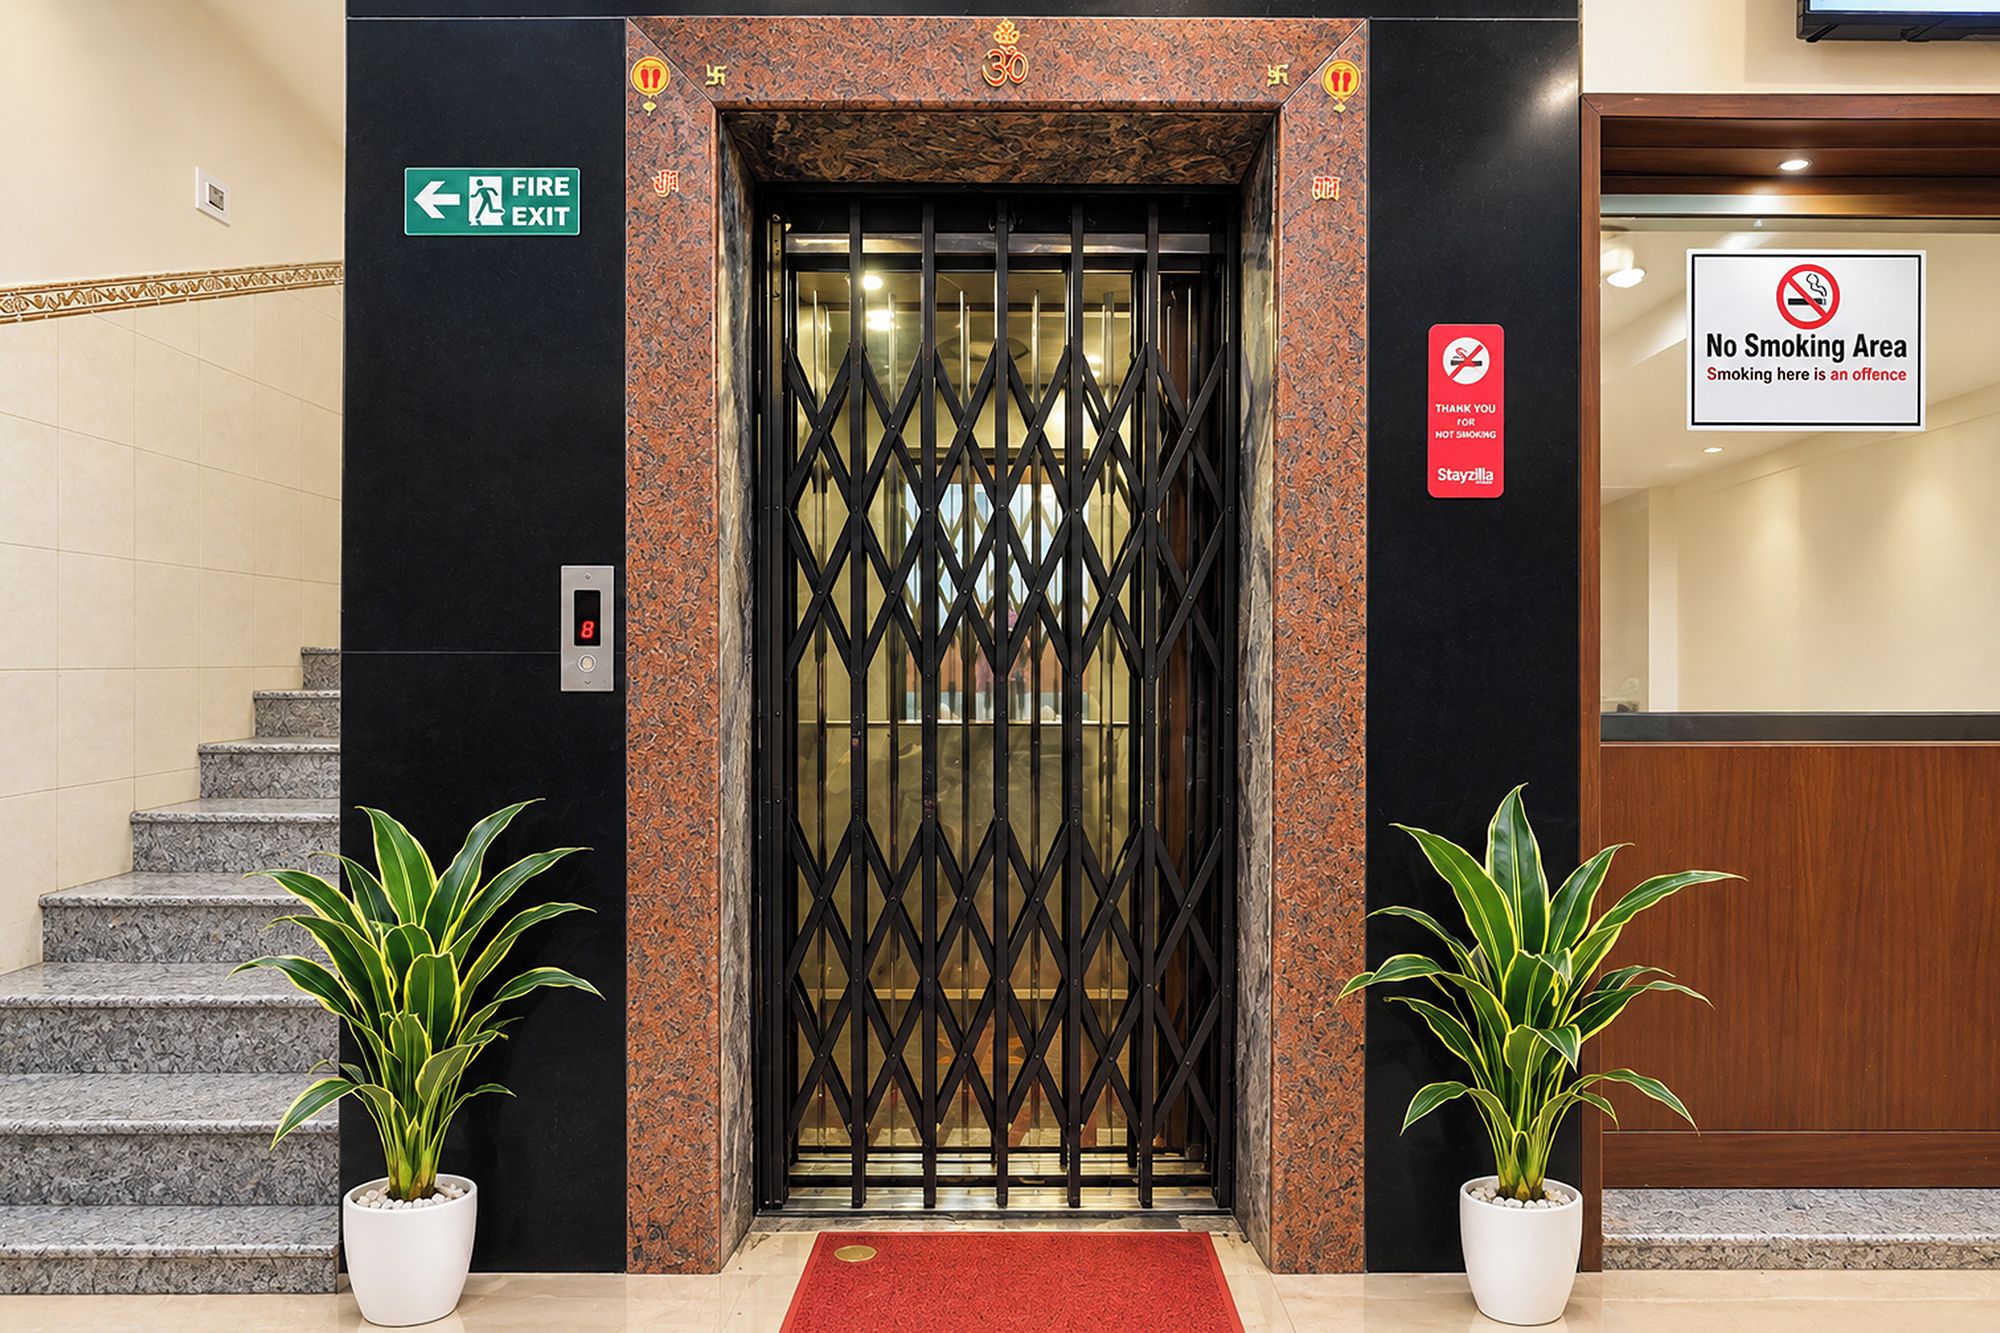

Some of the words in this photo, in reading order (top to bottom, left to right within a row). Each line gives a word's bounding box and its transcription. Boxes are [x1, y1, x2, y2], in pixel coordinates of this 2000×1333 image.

[512, 176, 570, 197] FIRE
[512, 207, 571, 226] EXIT
[1706, 333, 1737, 358] No
[1745, 333, 1845, 363] Smoking
[1852, 333, 1907, 358] Area
[1707, 367, 1773, 384] Smoking
[1777, 367, 1810, 381] here
[1814, 367, 1826, 381] is
[1830, 370, 1847, 381] an
[1852, 367, 1907, 381] offence
[1435, 404, 1471, 413] THANK
[1473, 404, 1496, 413] YOU
[1457, 418, 1475, 426] FOR
[1435, 431, 1455, 439] NOT
[1437, 467, 1494, 484] Stayzilla
[580, 620, 595, 639] 8
